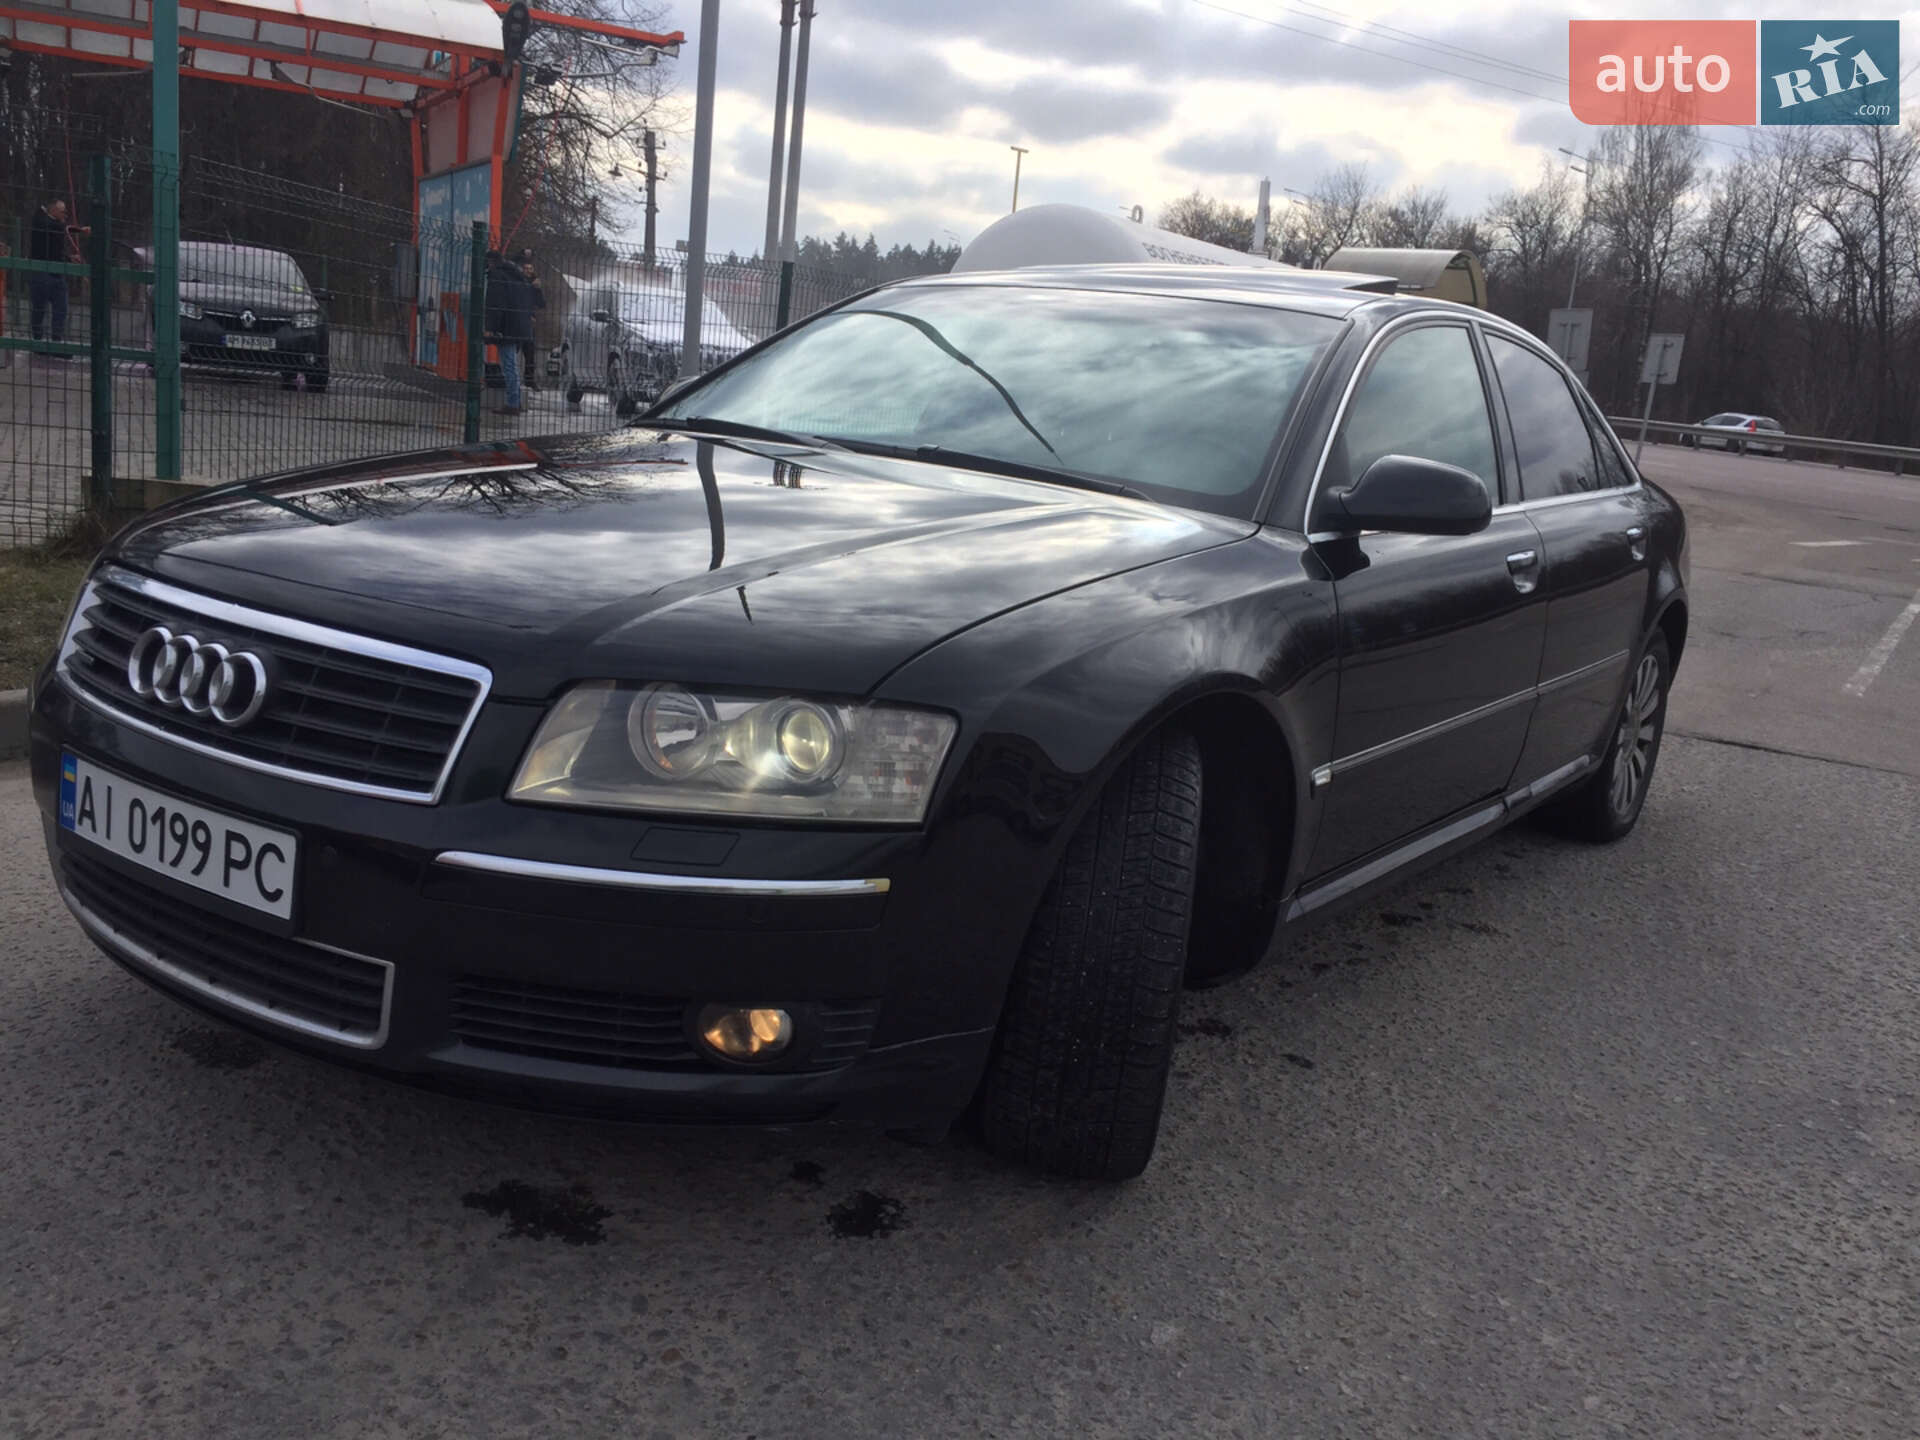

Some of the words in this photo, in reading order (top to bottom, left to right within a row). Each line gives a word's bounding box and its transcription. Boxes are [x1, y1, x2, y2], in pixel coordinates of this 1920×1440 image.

[78, 775, 112, 840] AI
[128, 798, 212, 876] 0199
[223, 829, 286, 903] PC
